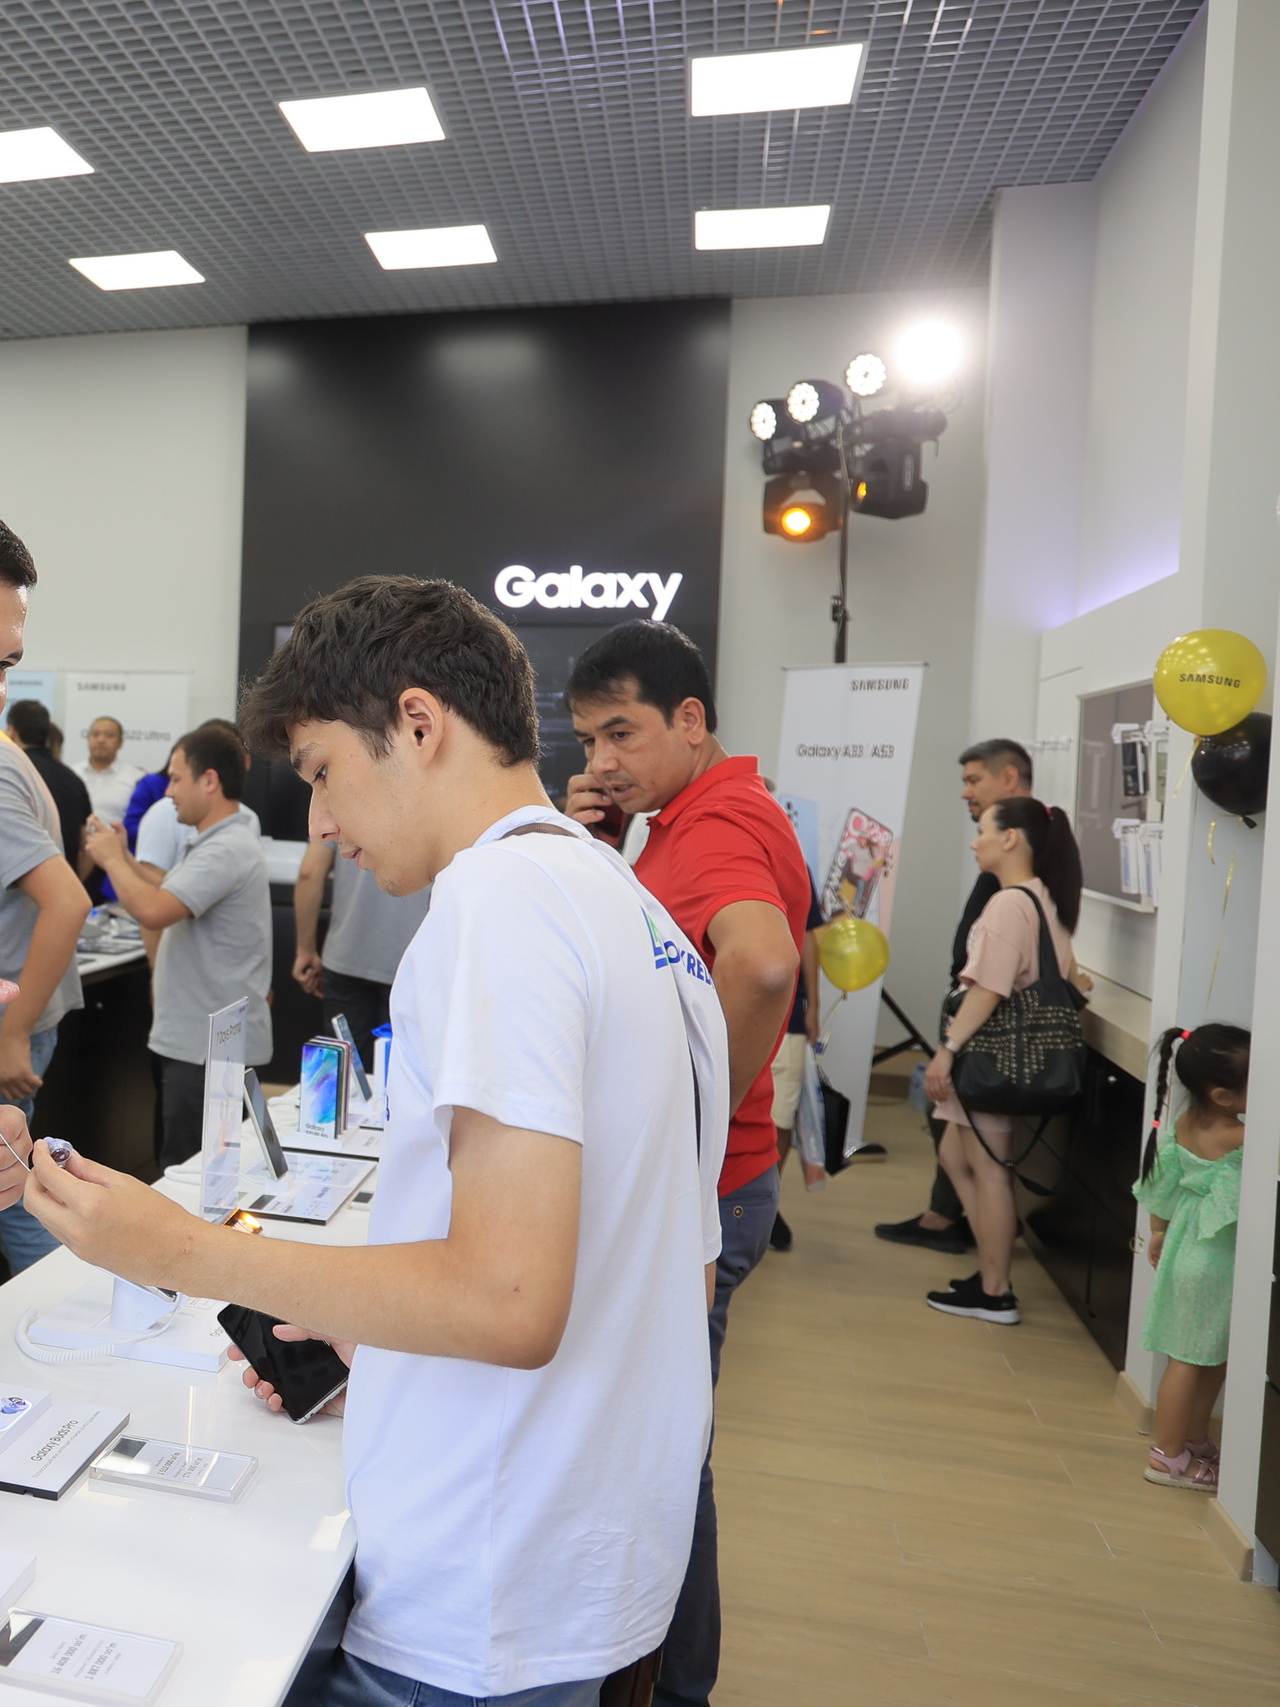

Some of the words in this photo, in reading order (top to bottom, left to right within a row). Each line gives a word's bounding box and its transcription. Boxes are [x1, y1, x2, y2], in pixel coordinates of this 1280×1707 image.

[494, 564, 683, 622] Galaxy
[77, 682, 127, 692] SAMSUNG
[850, 679, 909, 691] SAMSUNG
[1179, 673, 1241, 688] SAMSUNG
[796, 744, 841, 760] Galaxy
[31, 1440, 60, 1462] Galaxy
[62, 1419, 79, 1430] Pro
